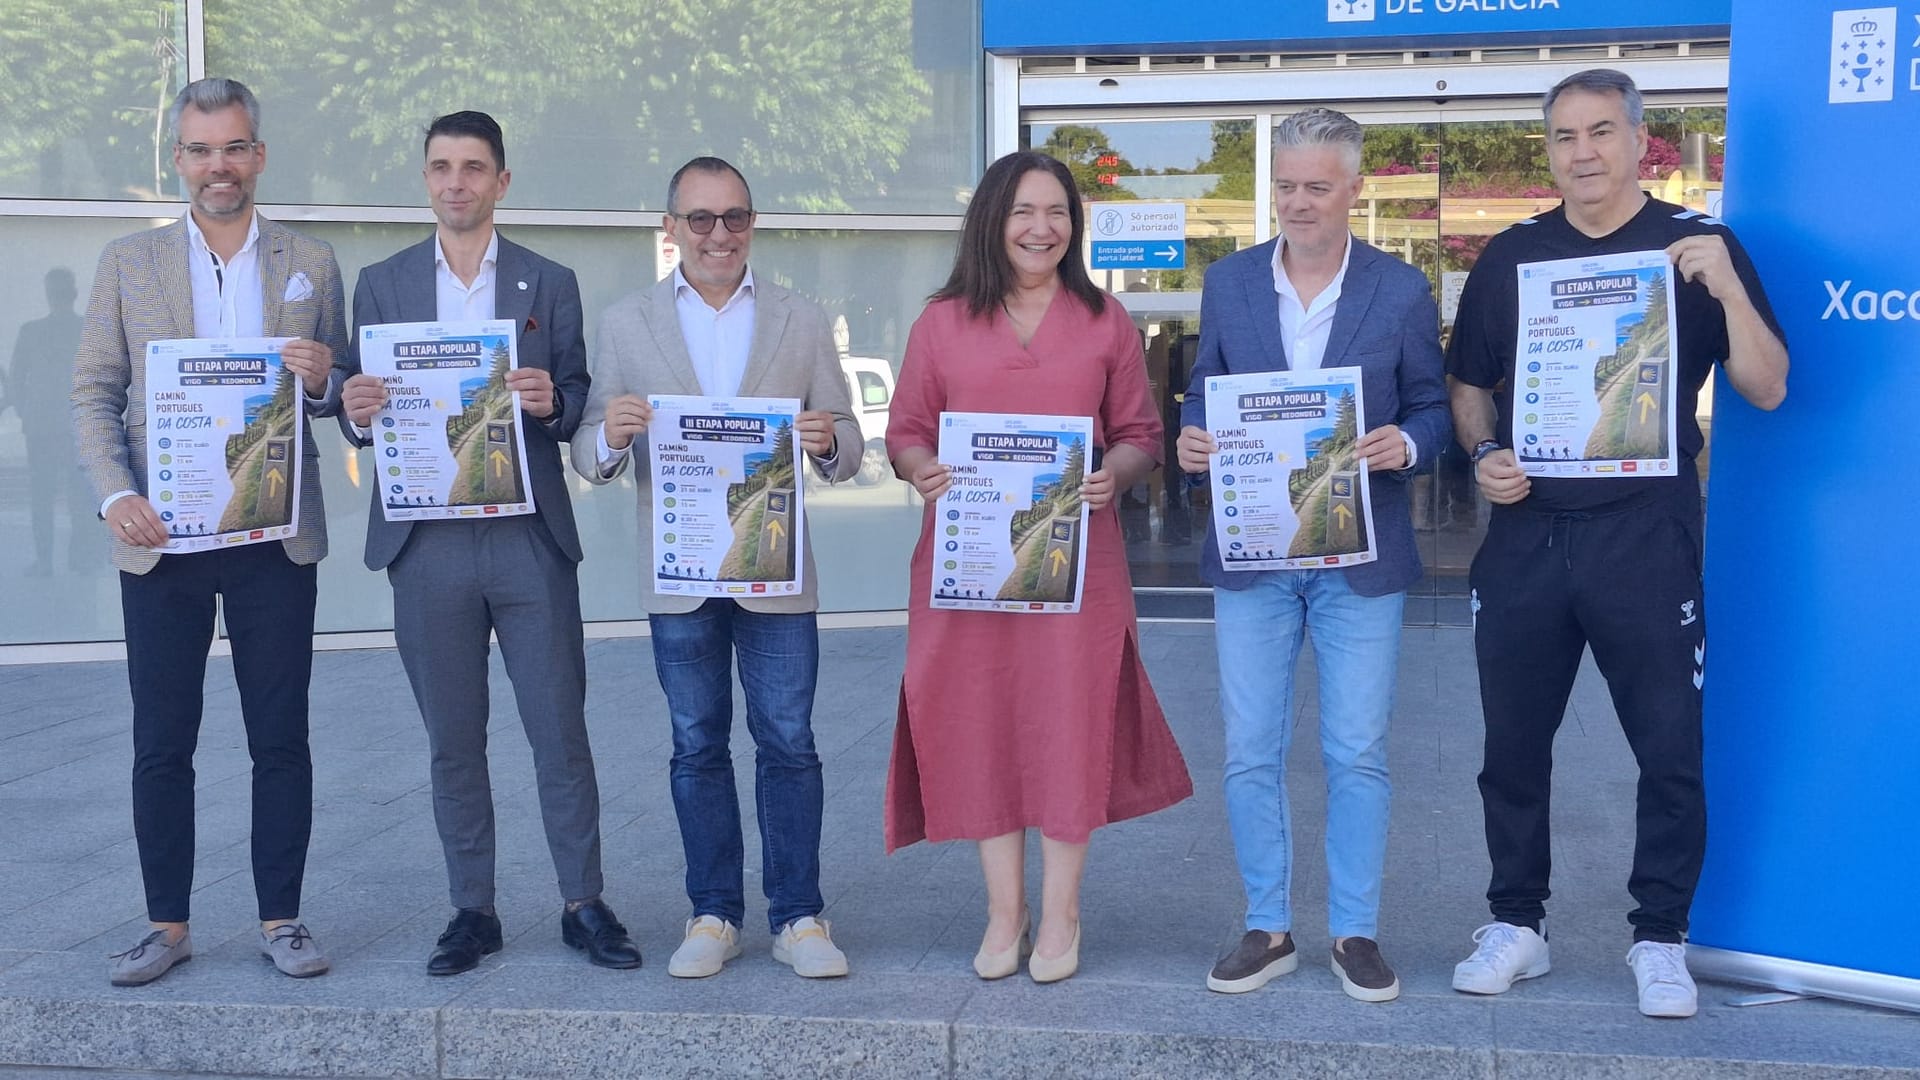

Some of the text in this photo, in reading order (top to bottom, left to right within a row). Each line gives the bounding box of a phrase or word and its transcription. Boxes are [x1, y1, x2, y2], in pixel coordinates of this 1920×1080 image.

[1386, 0, 1423, 14] DE
[1130, 212, 1177, 222] Só persoal
[1130, 222, 1178, 232] autorizado
[1128, 247, 1144, 255] pola
[1098, 254, 1118, 262] porta
[1556, 278, 1632, 294] III ETAPA POPULAR
[400, 343, 476, 356] III ETAPA POPULAR
[1528, 338, 1583, 354] DA COSTA
[184, 360, 262, 372] III ETAPA POPULAR
[382, 376, 403, 384] MIÑO
[396, 399, 430, 410] COSTA
[1244, 392, 1322, 408] III ETAPA POPULAR
[157, 416, 212, 430] DA COSTA
[686, 419, 760, 430] III ETAPA POPULAR
[977, 436, 1052, 449] III ETAPA POPULAR
[1013, 454, 1052, 462] REDONDELA
[1220, 452, 1274, 467] DA COSTA
[662, 466, 714, 476] DA COSTA
[947, 491, 1000, 503] DA COSTA
